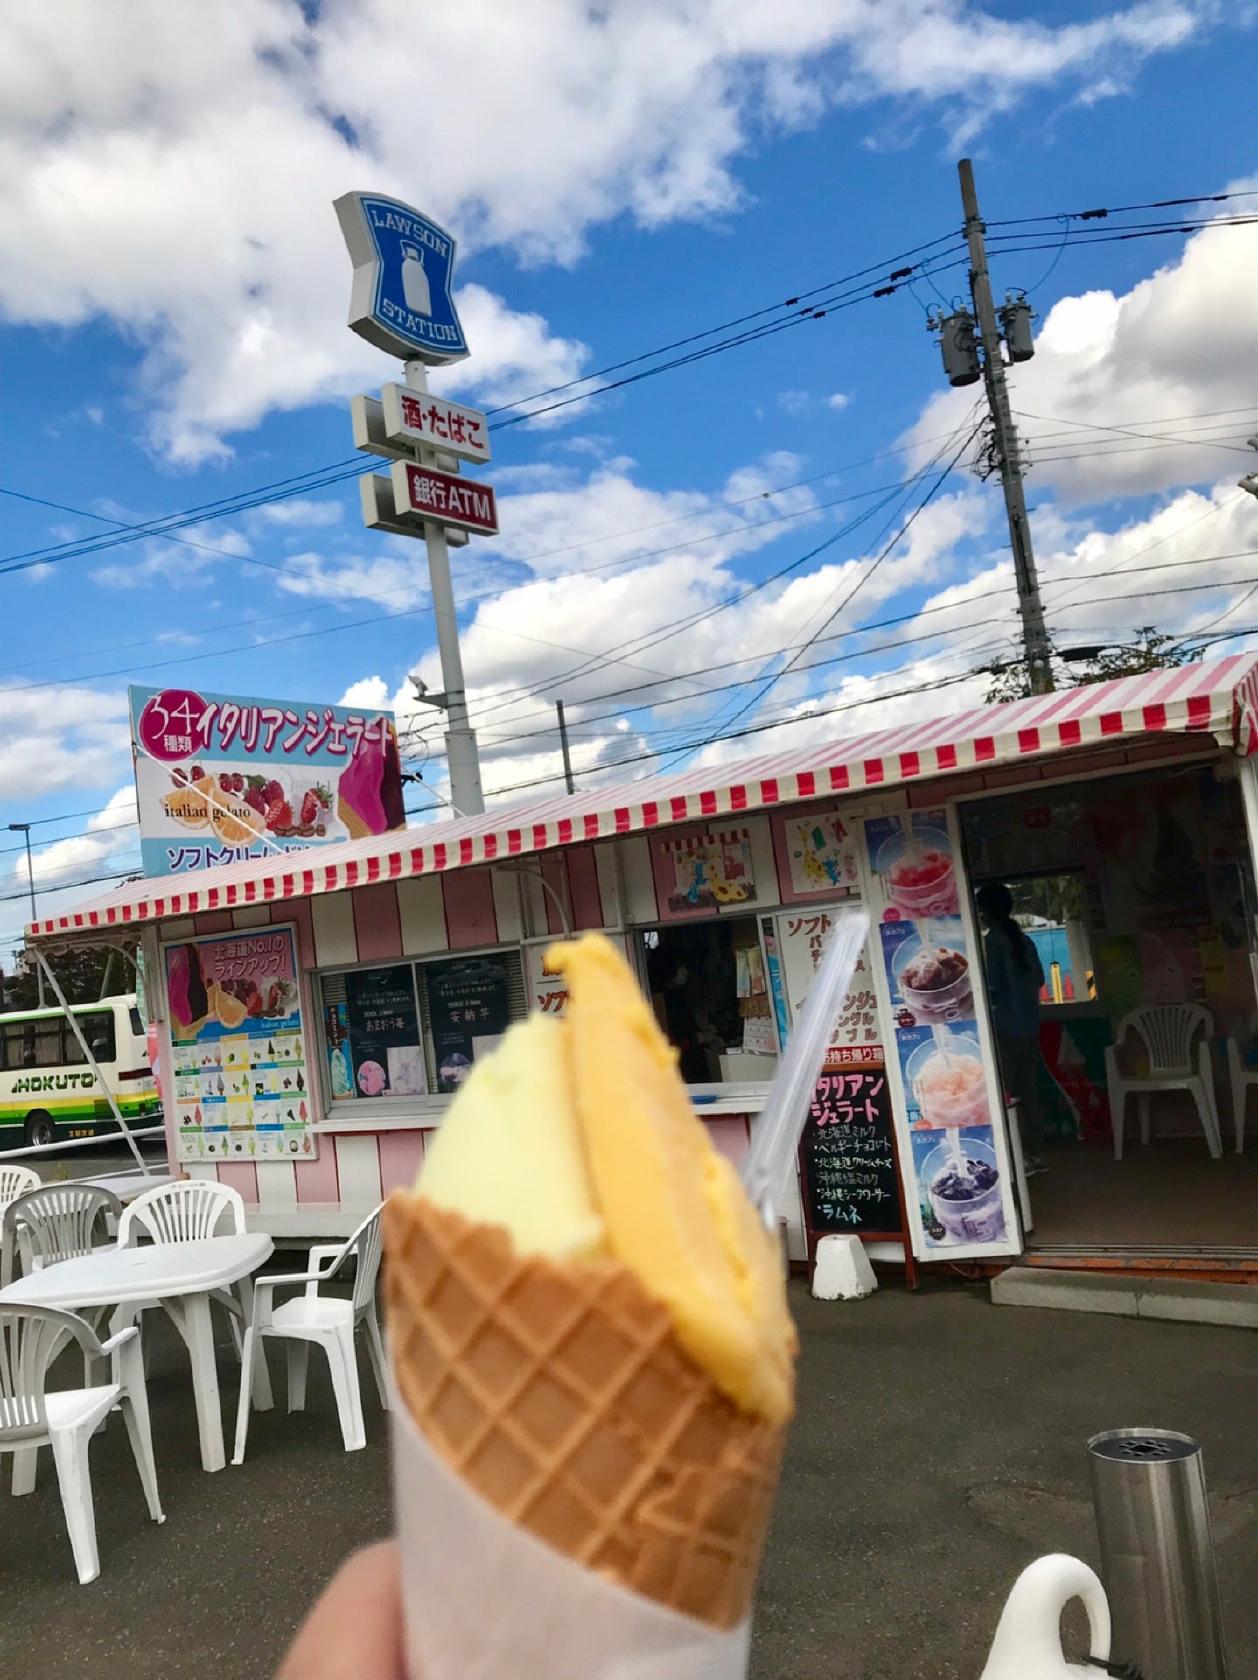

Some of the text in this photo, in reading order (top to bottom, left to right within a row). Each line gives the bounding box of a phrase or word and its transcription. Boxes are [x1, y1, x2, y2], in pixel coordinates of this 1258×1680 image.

[370, 210, 448, 258] LAWSON
[383, 298, 459, 341] STATION
[401, 395, 485, 449] 酒・たばこ
[413, 475, 492, 521] 銀行ATM
[163, 734, 193, 753] 種類
[198, 701, 393, 758] イタリアンジェラート
[164, 803, 207, 818] italian
[16, 1072, 95, 1093] HOKUTO
[810, 1098, 880, 1126] ジェラート
[822, 1203, 863, 1225] ラムネ
